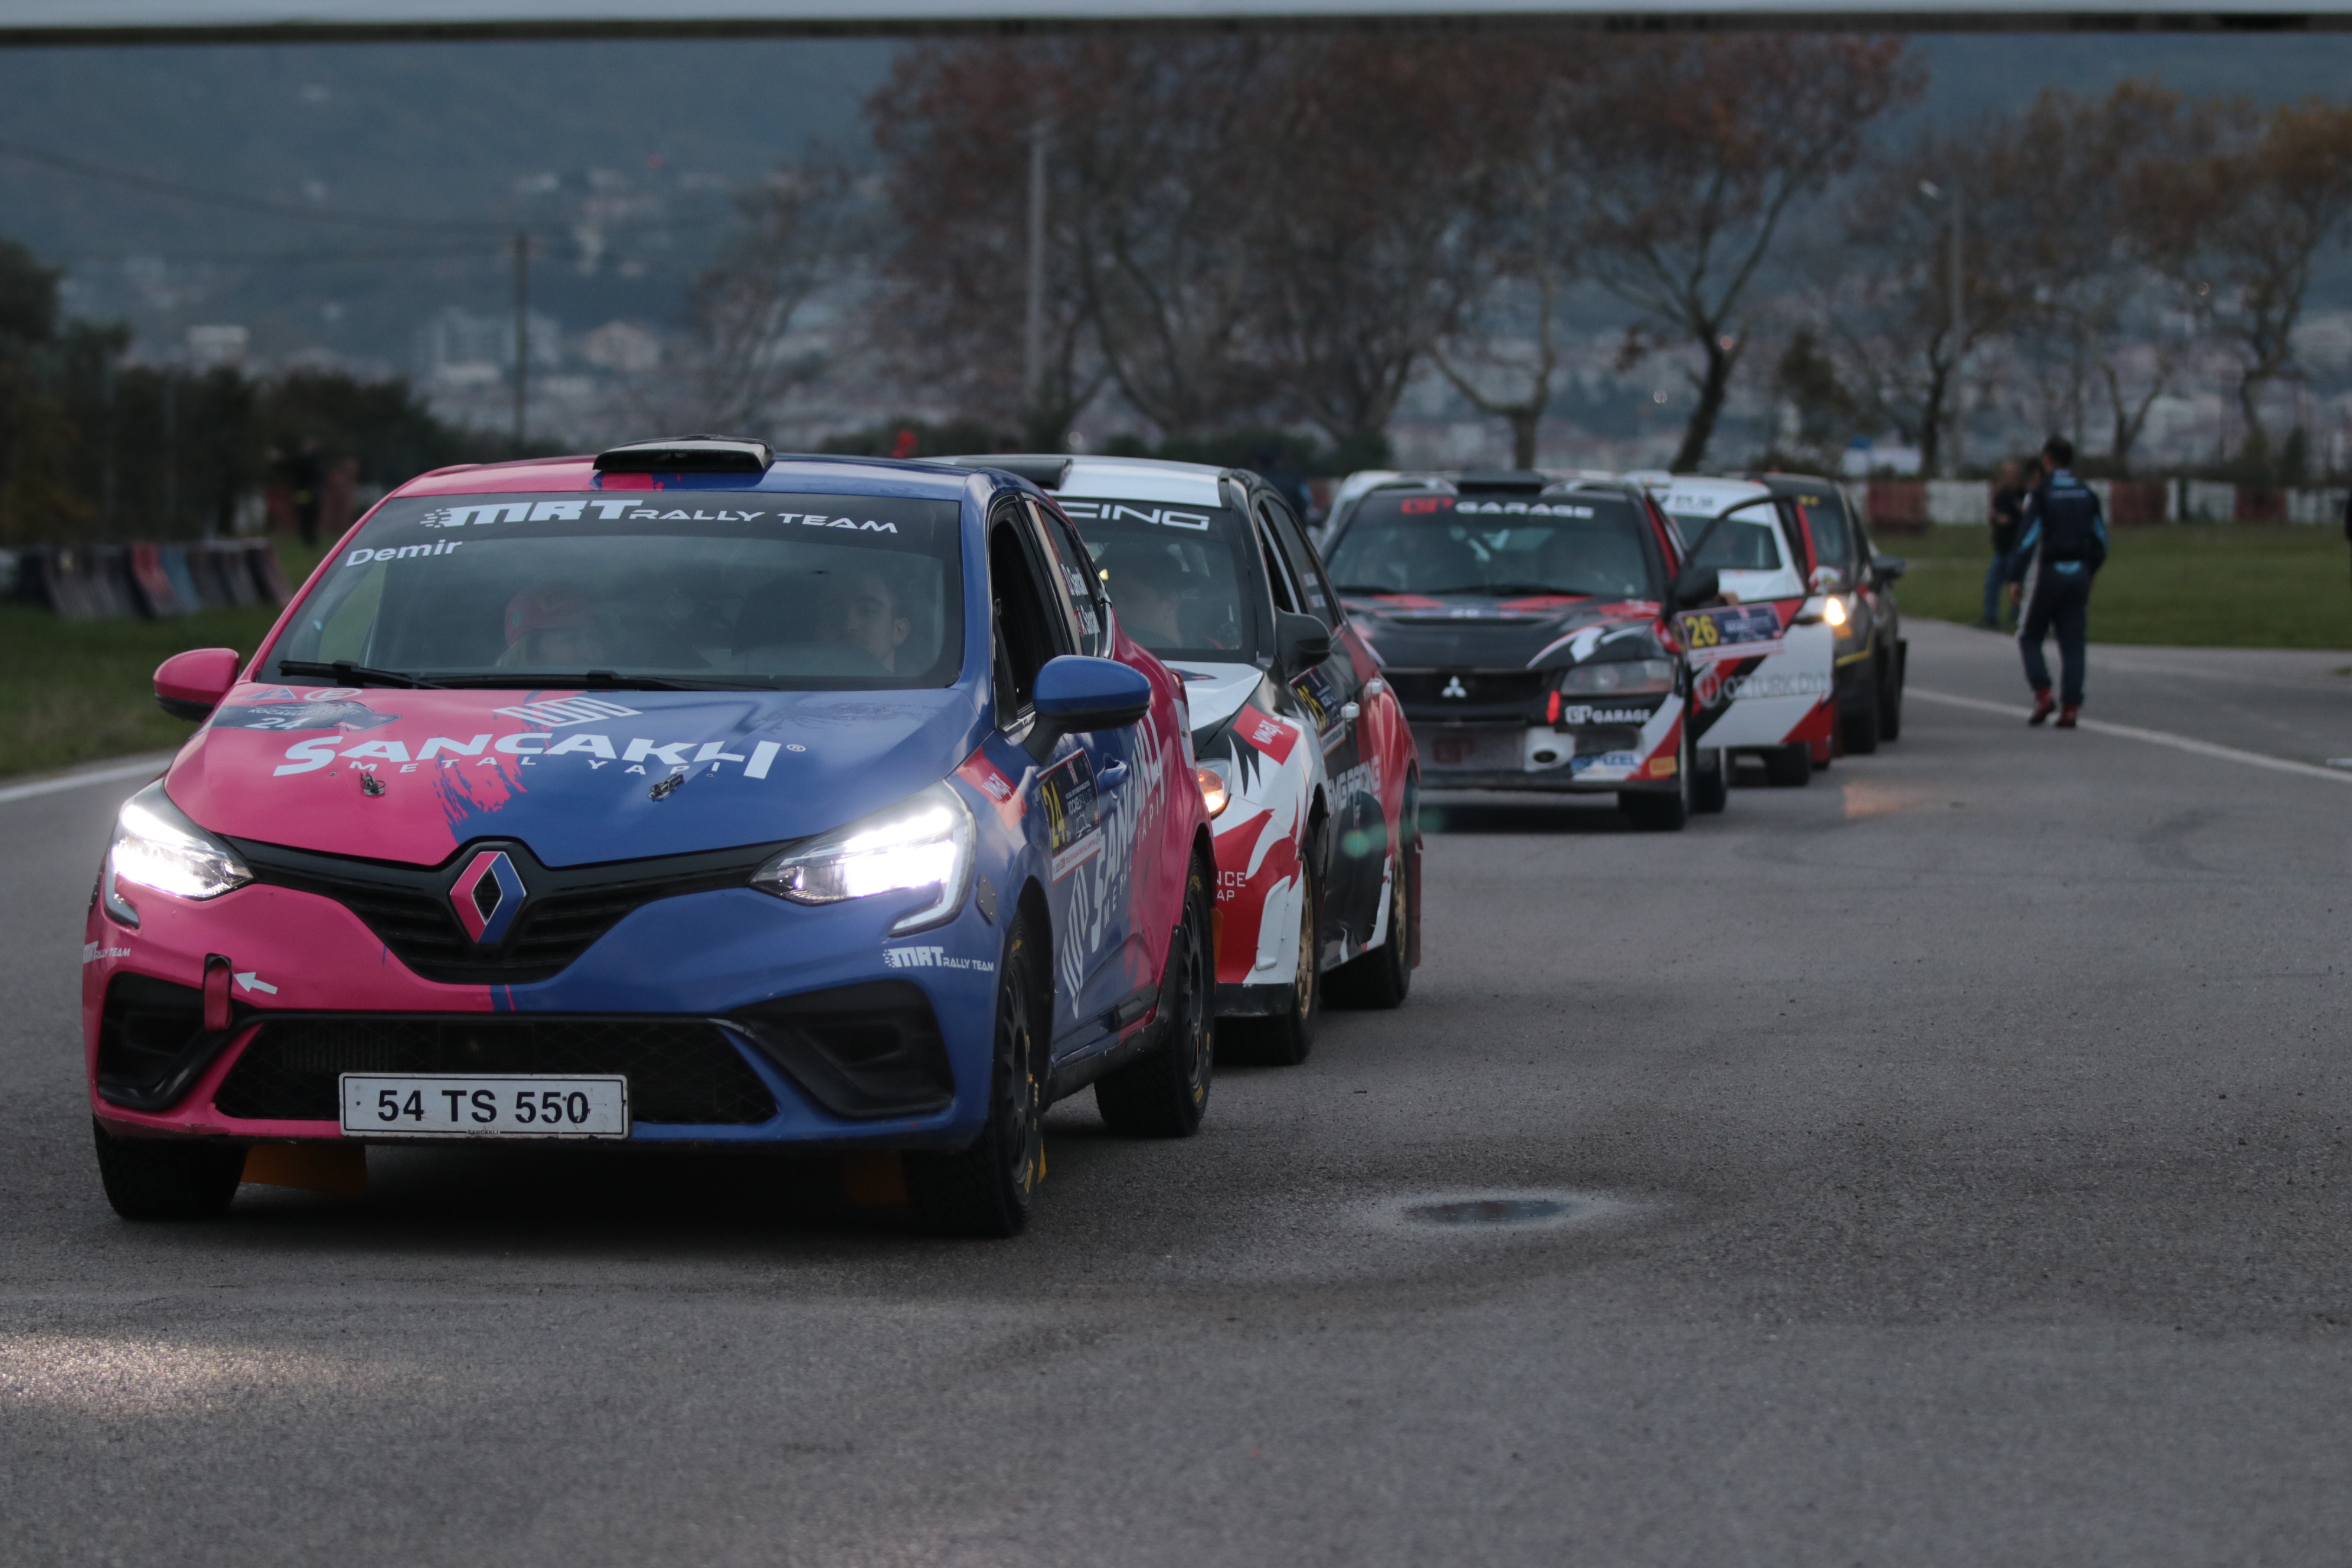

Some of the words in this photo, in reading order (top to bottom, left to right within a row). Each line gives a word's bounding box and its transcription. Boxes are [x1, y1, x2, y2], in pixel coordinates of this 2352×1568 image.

[442, 499, 643, 528] MRT
[629, 509, 766, 521] RALLY
[777, 512, 898, 533] TEAM
[1455, 501, 1594, 520] GARAGE
[345, 540, 463, 567] Demir
[1685, 615, 1719, 648] 26
[245, 717, 312, 730] 24
[1593, 708, 1651, 724] GARAGE
[273, 734, 781, 779] SANCAKLI
[349, 757, 536, 773] METAL
[588, 760, 720, 775] YAPI
[1041, 781, 1066, 849] 24
[109, 948, 131, 957] TEAM
[888, 946, 944, 968] MRT
[943, 958, 970, 969] RALLY
[972, 959, 994, 972] TEAM
[378, 1090, 424, 1122] 54
[442, 1090, 497, 1123] TS
[515, 1092, 591, 1123] 550
